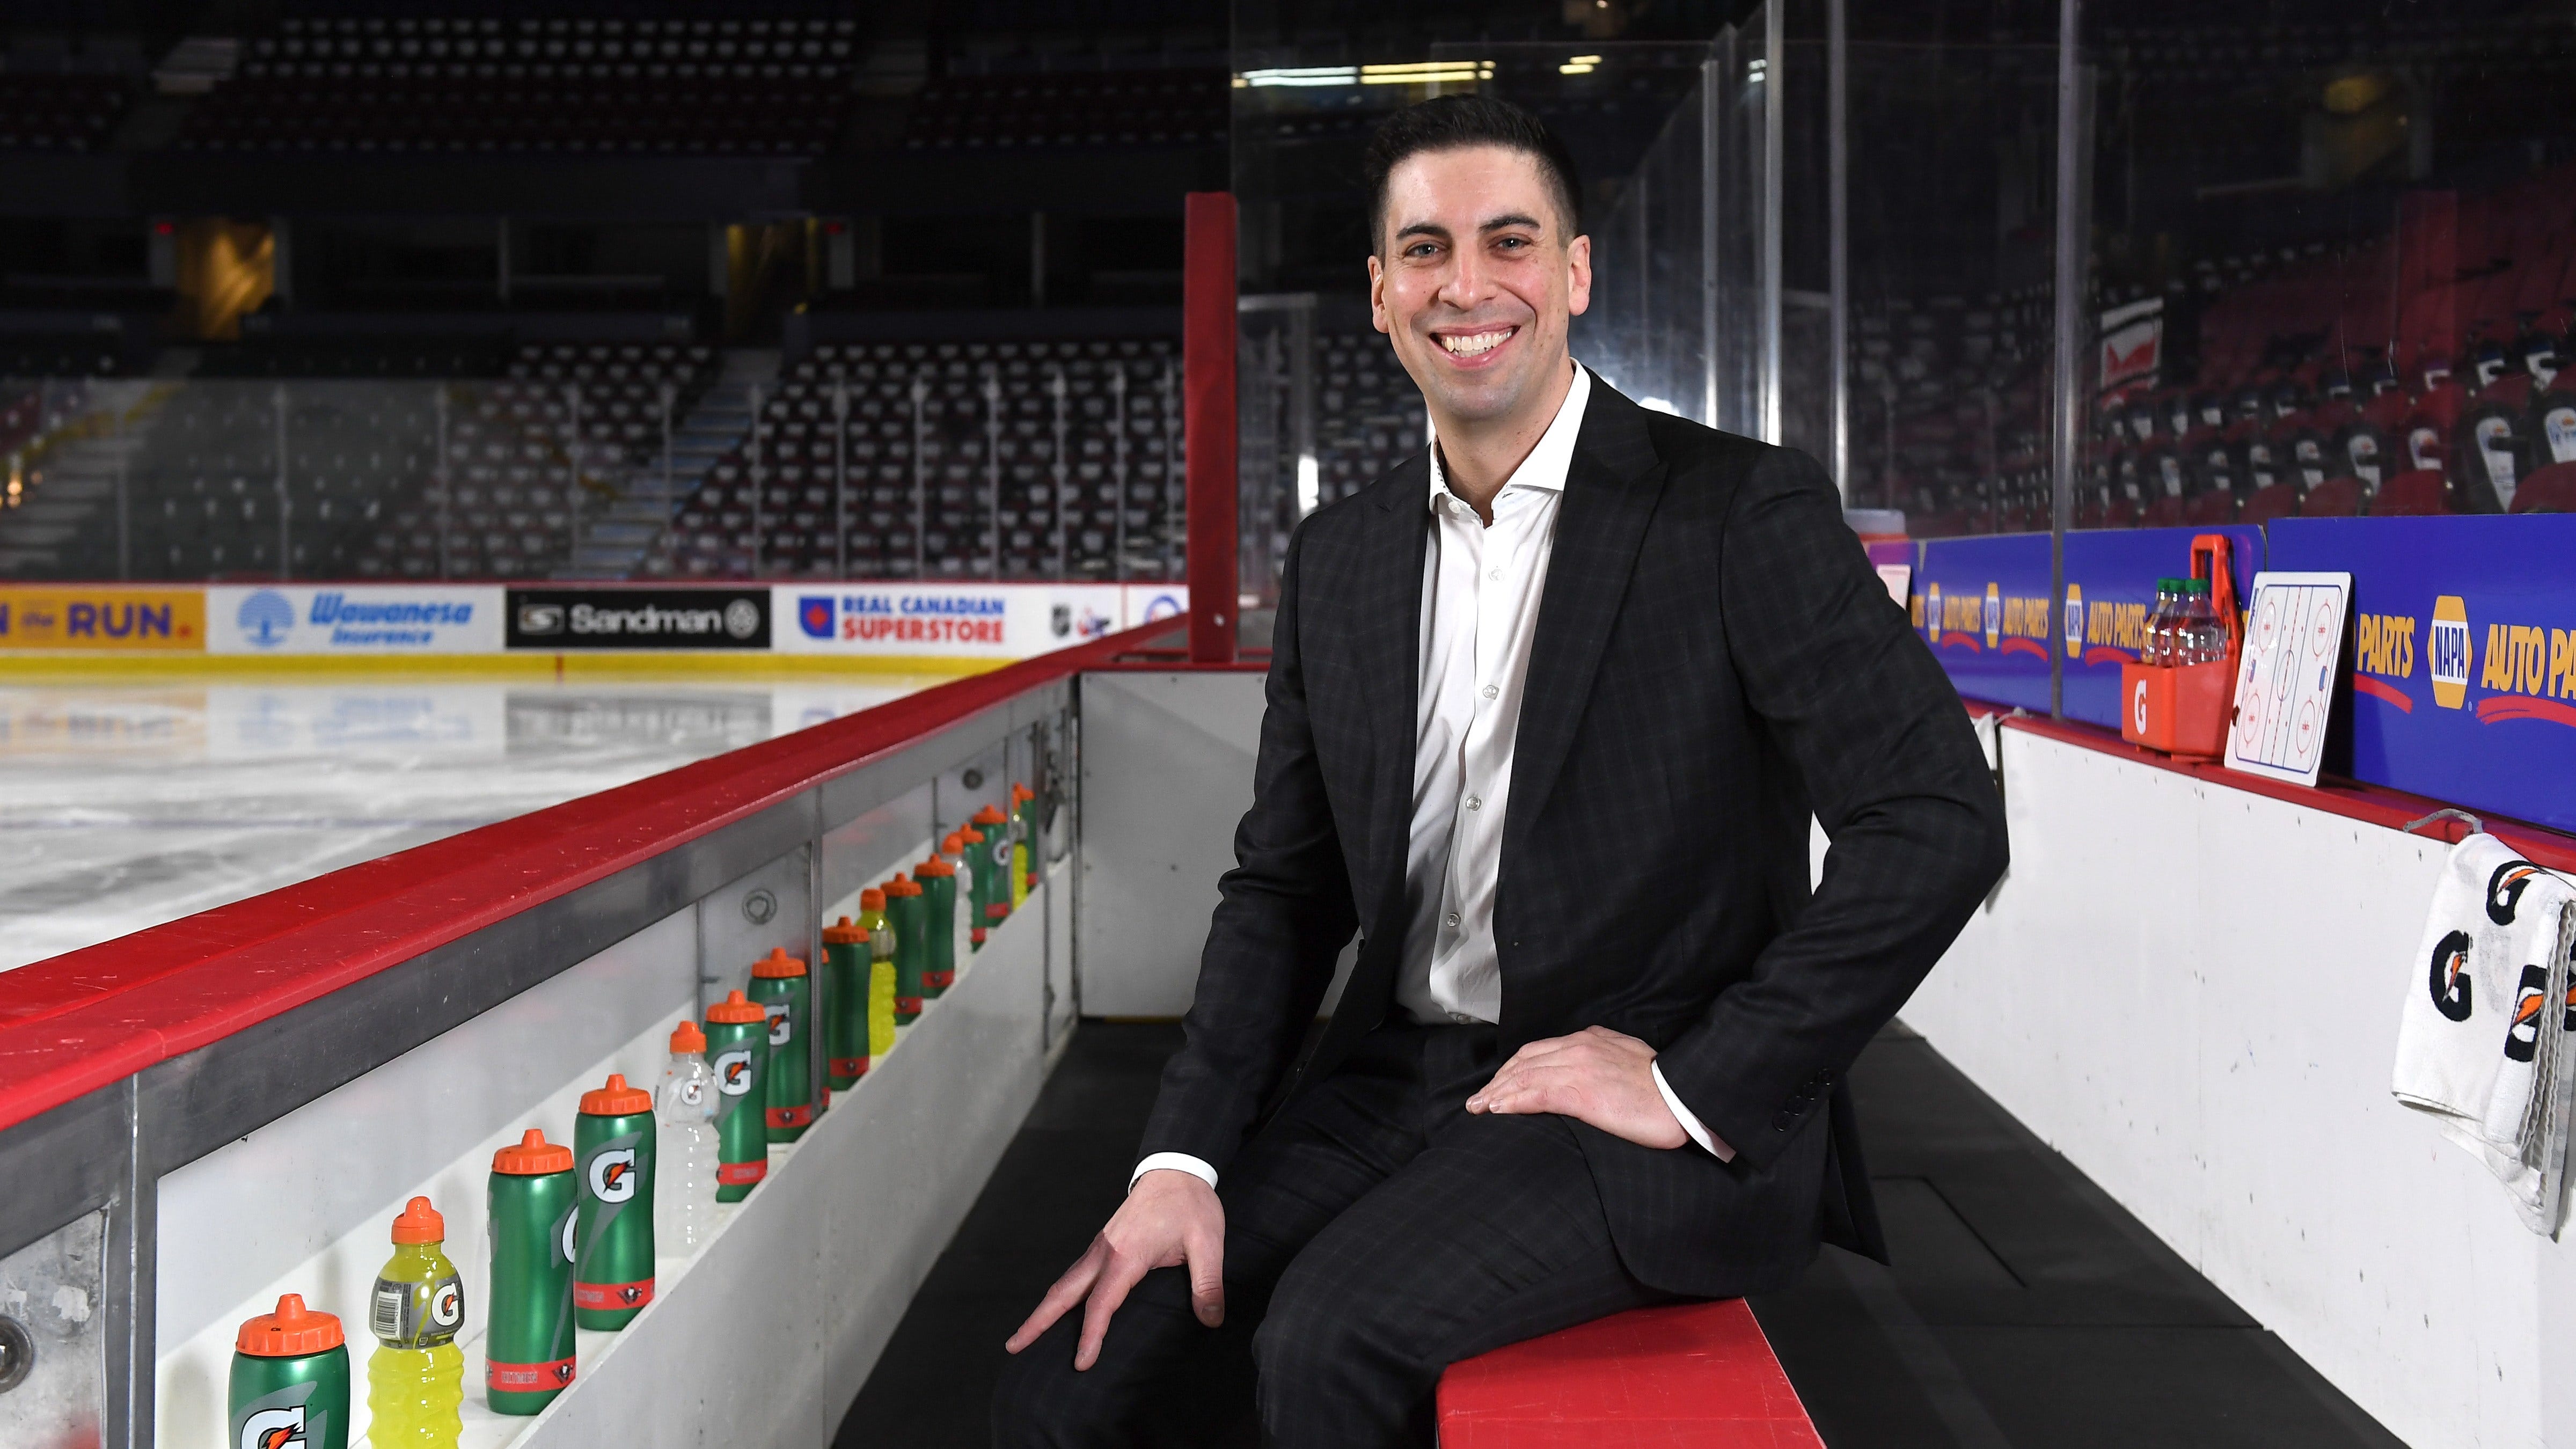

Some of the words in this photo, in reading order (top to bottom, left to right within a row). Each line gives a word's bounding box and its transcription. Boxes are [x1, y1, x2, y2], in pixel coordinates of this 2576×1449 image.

[309, 591, 473, 625] Wawanesa
[570, 603, 722, 634] Sandman
[843, 596, 891, 614] REAL
[901, 596, 1005, 614] CANADIAN
[2087, 601, 2113, 645] AUTO
[843, 618, 1004, 643] SUPERSTORE
[2357, 613, 2415, 678] PARTS
[2435, 626, 2465, 678] NAPA
[2480, 623, 2546, 696] AUTO
[2134, 679, 2147, 735] G
[2429, 930, 2472, 1022] G
[680, 1079, 703, 1106] G
[714, 1050, 751, 1096] G
[588, 1147, 636, 1204] G
[431, 1282, 459, 1327] G
